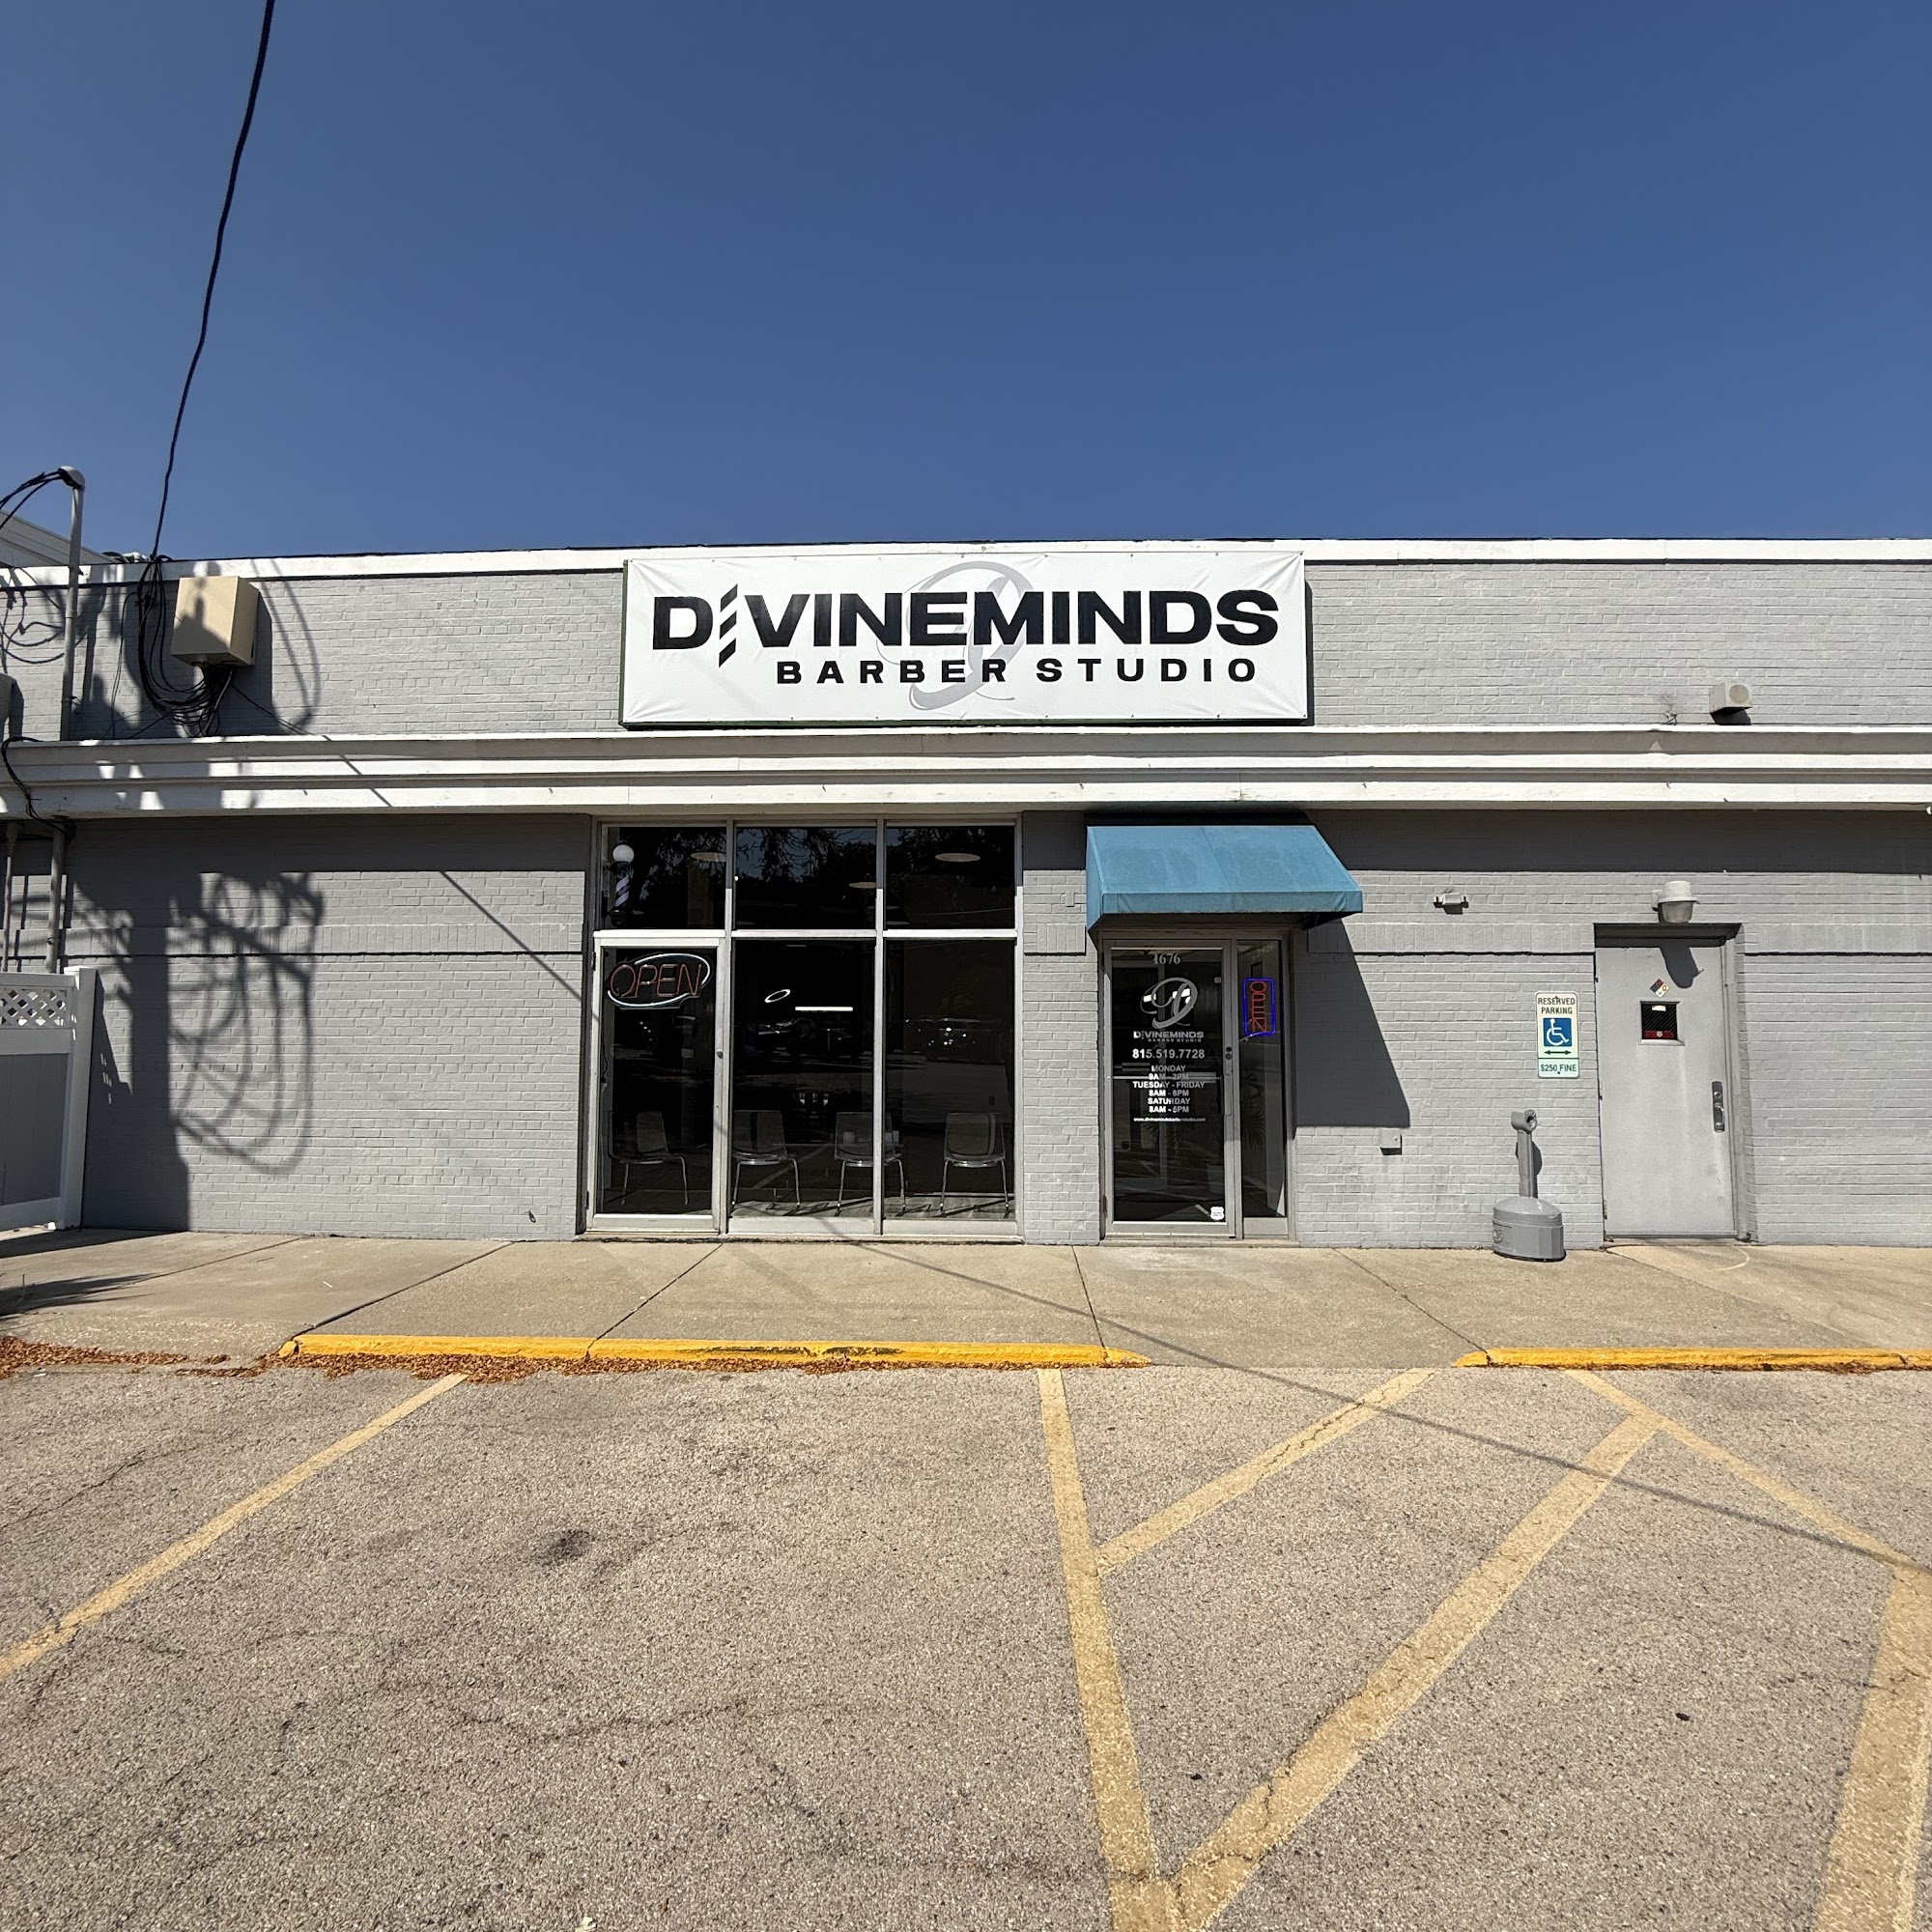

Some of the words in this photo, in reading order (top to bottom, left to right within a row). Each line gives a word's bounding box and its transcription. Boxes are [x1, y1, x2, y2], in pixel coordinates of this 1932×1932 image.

[777, 659, 1007, 684] BARBER
[1037, 657, 1256, 683] STUDIO
[1152, 952, 1181, 965] 1676
[611, 964, 703, 997] OPEN
[1250, 980, 1267, 1033] OPEN
[1538, 997, 1576, 1006] RESERVED
[1541, 1007, 1573, 1015] PARKING
[1132, 1048, 1206, 1059] 815.519.7728
[1540, 1064, 1558, 1072] $250
[1559, 1064, 1577, 1072] FINE
